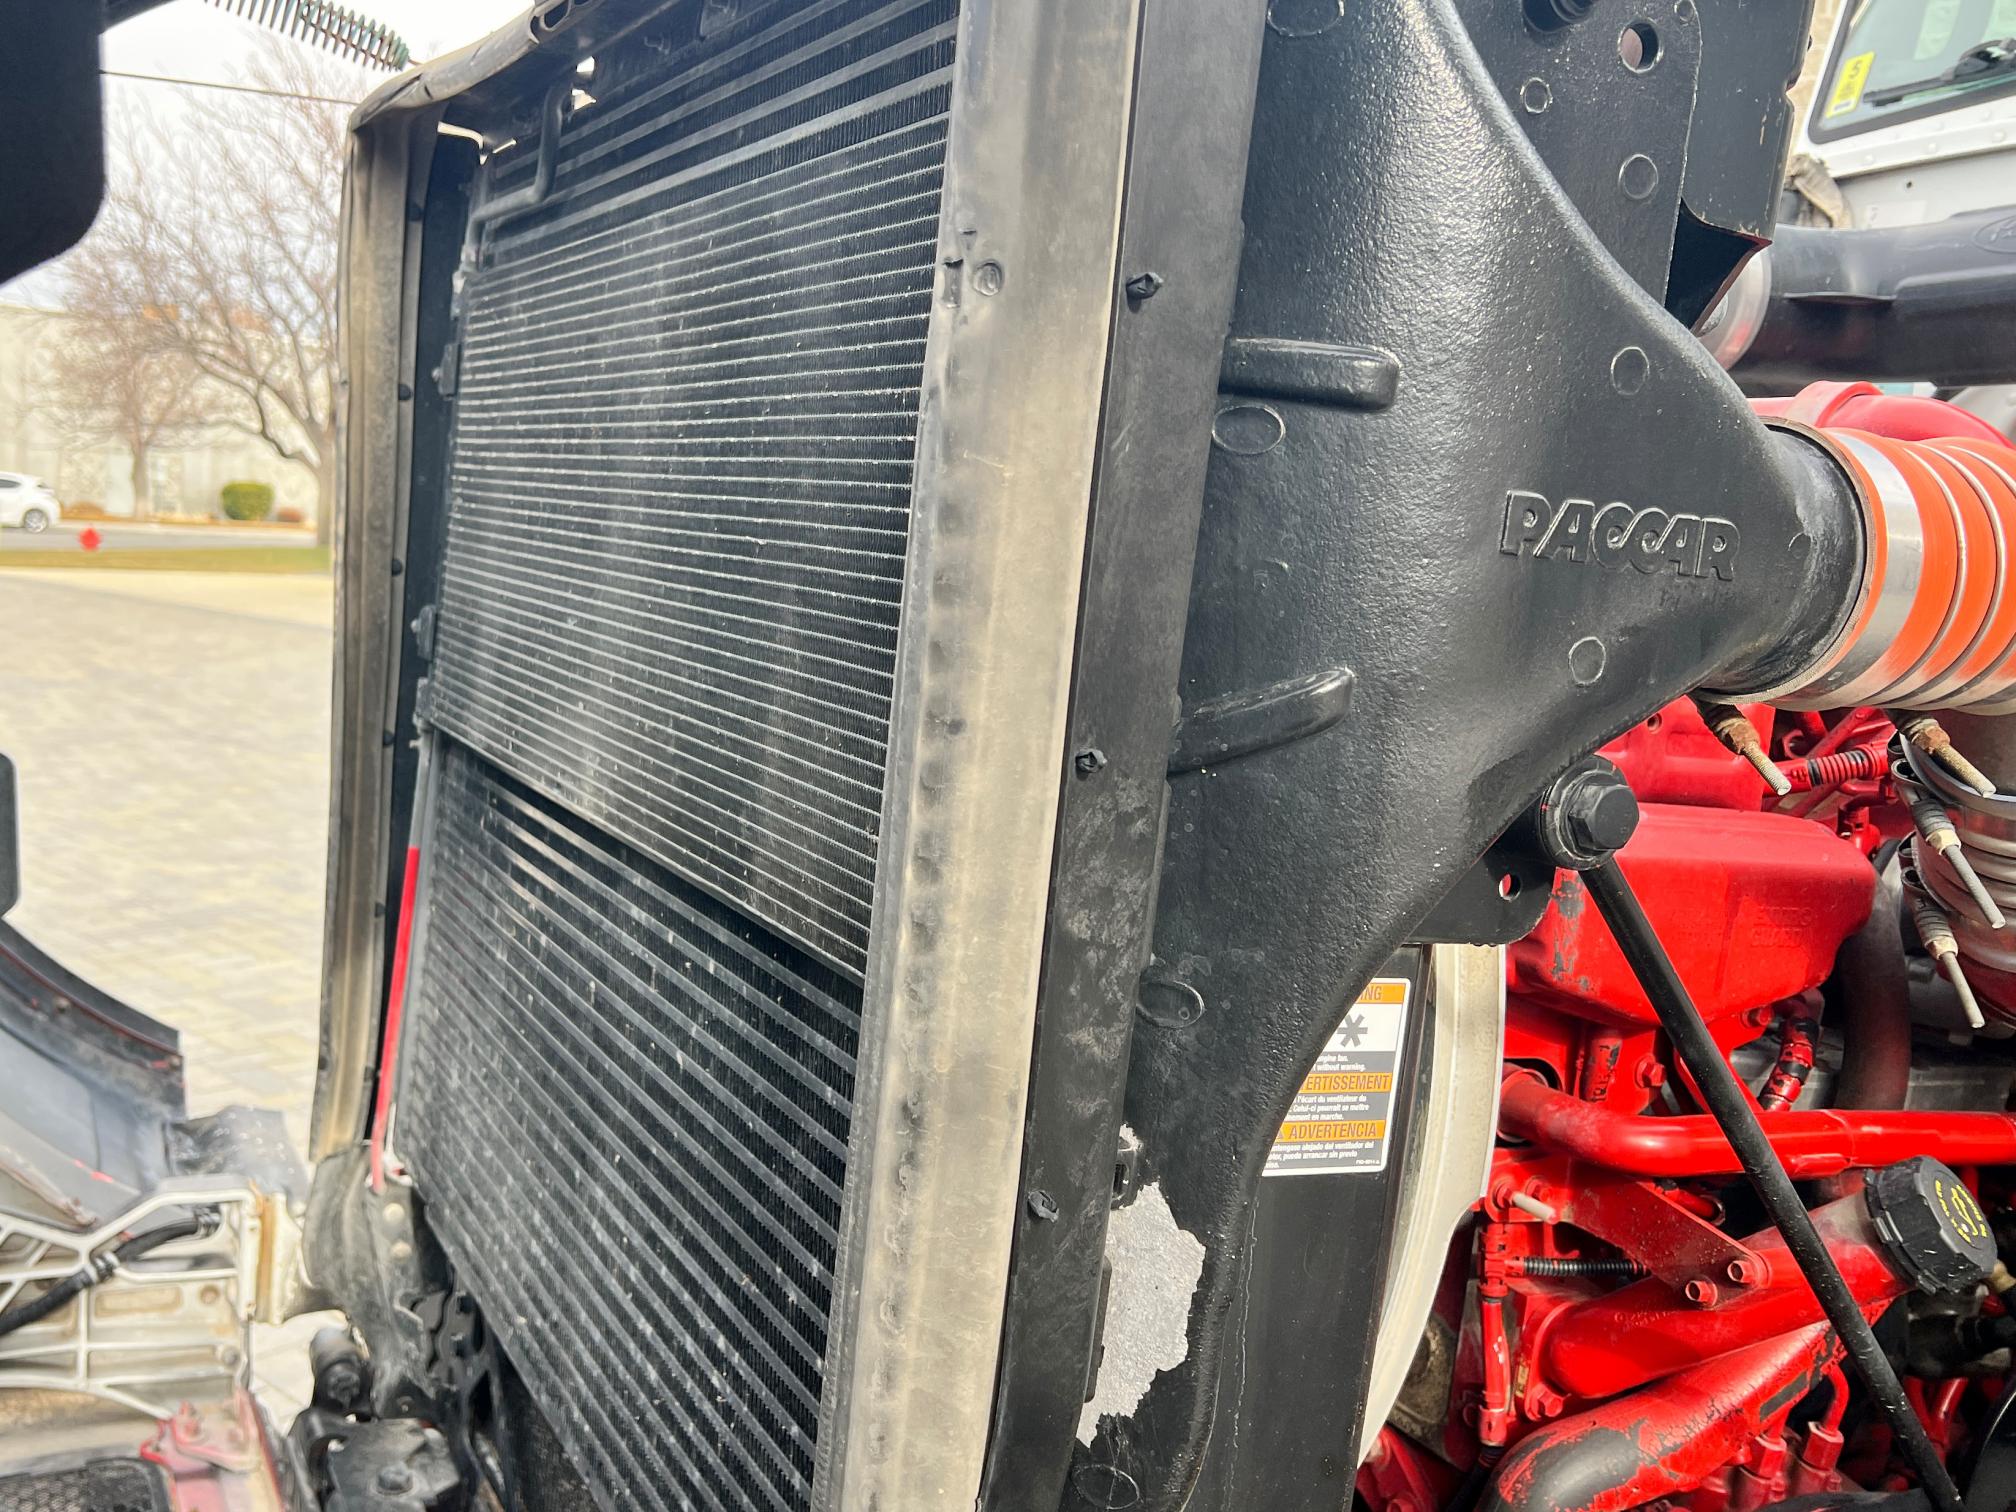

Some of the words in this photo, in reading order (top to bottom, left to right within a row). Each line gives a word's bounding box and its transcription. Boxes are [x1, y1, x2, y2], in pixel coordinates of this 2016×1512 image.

[1500, 490, 1740, 581] PACCAR
[1302, 1075, 1390, 1091] ERTISSEMENT
[1289, 1122, 1377, 1140] ADVERTENCIA
